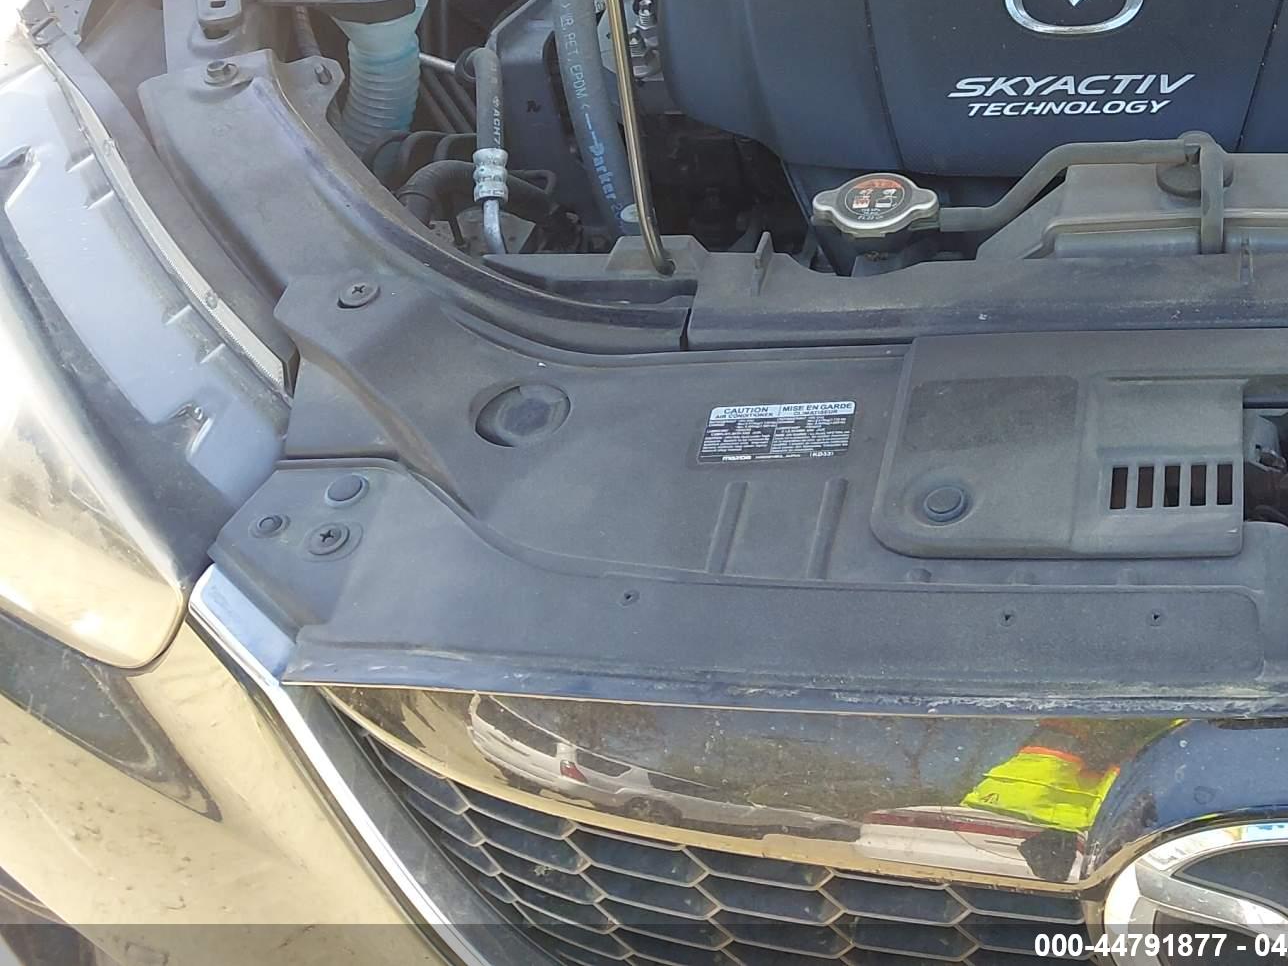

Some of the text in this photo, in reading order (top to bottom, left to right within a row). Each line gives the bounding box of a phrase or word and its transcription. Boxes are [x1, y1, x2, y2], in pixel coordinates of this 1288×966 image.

[947, 73, 1195, 98] SKYACTIV
[967, 99, 1171, 117] TECHNOLOGY
[588, 141, 618, 200] Parker
[723, 406, 769, 414] CAUTION
[820, 402, 853, 410] GARDE
